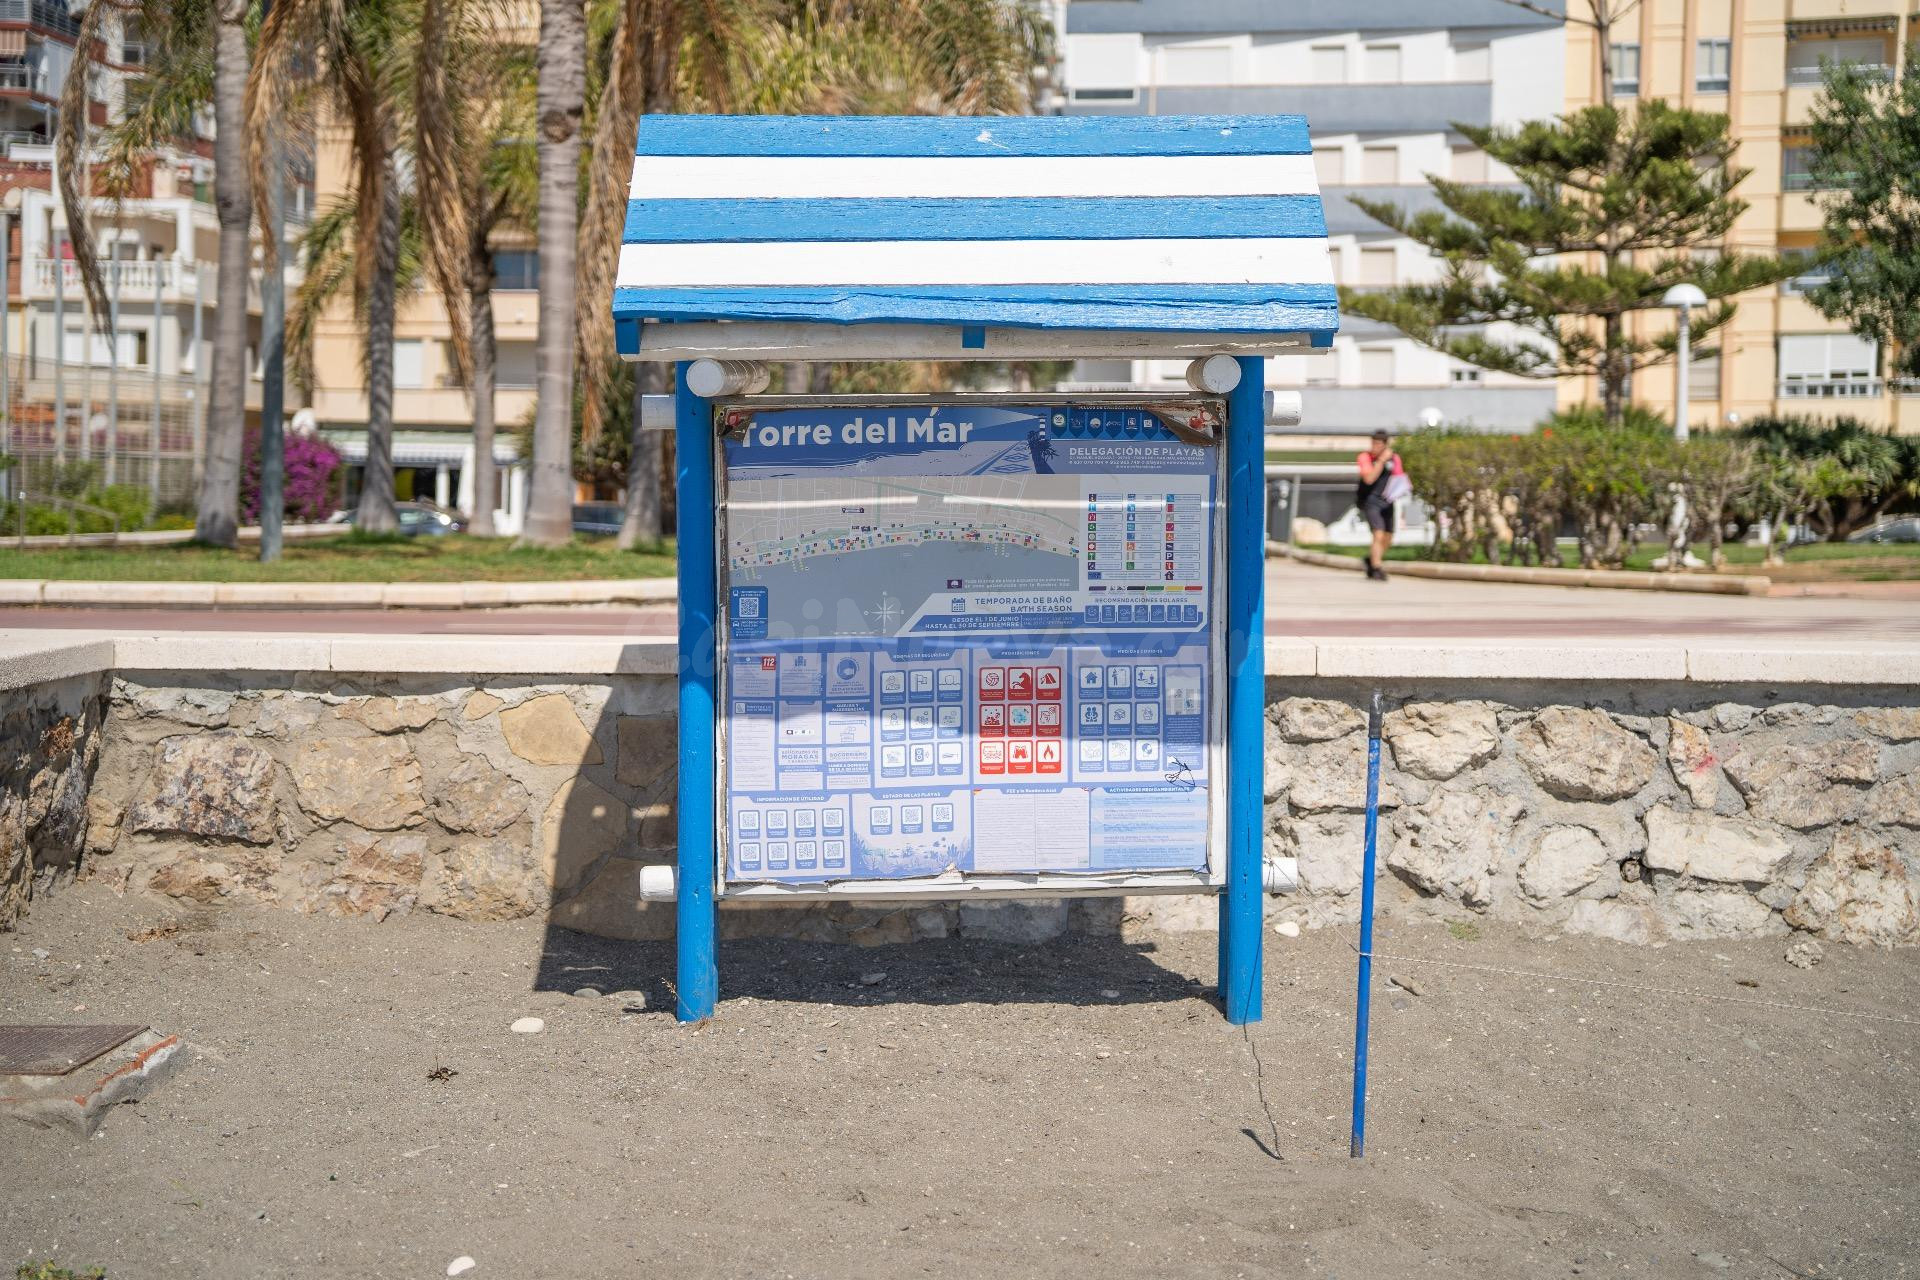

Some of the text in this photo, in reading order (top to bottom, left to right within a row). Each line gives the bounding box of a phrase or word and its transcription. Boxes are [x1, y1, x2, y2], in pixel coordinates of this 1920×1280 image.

[841, 416, 896, 444] del
[1070, 445, 1205, 456] DELEGACIÓN DE PLAYAS
[1046, 595, 1072, 604] BAÑO
[763, 658, 775, 667] 112
